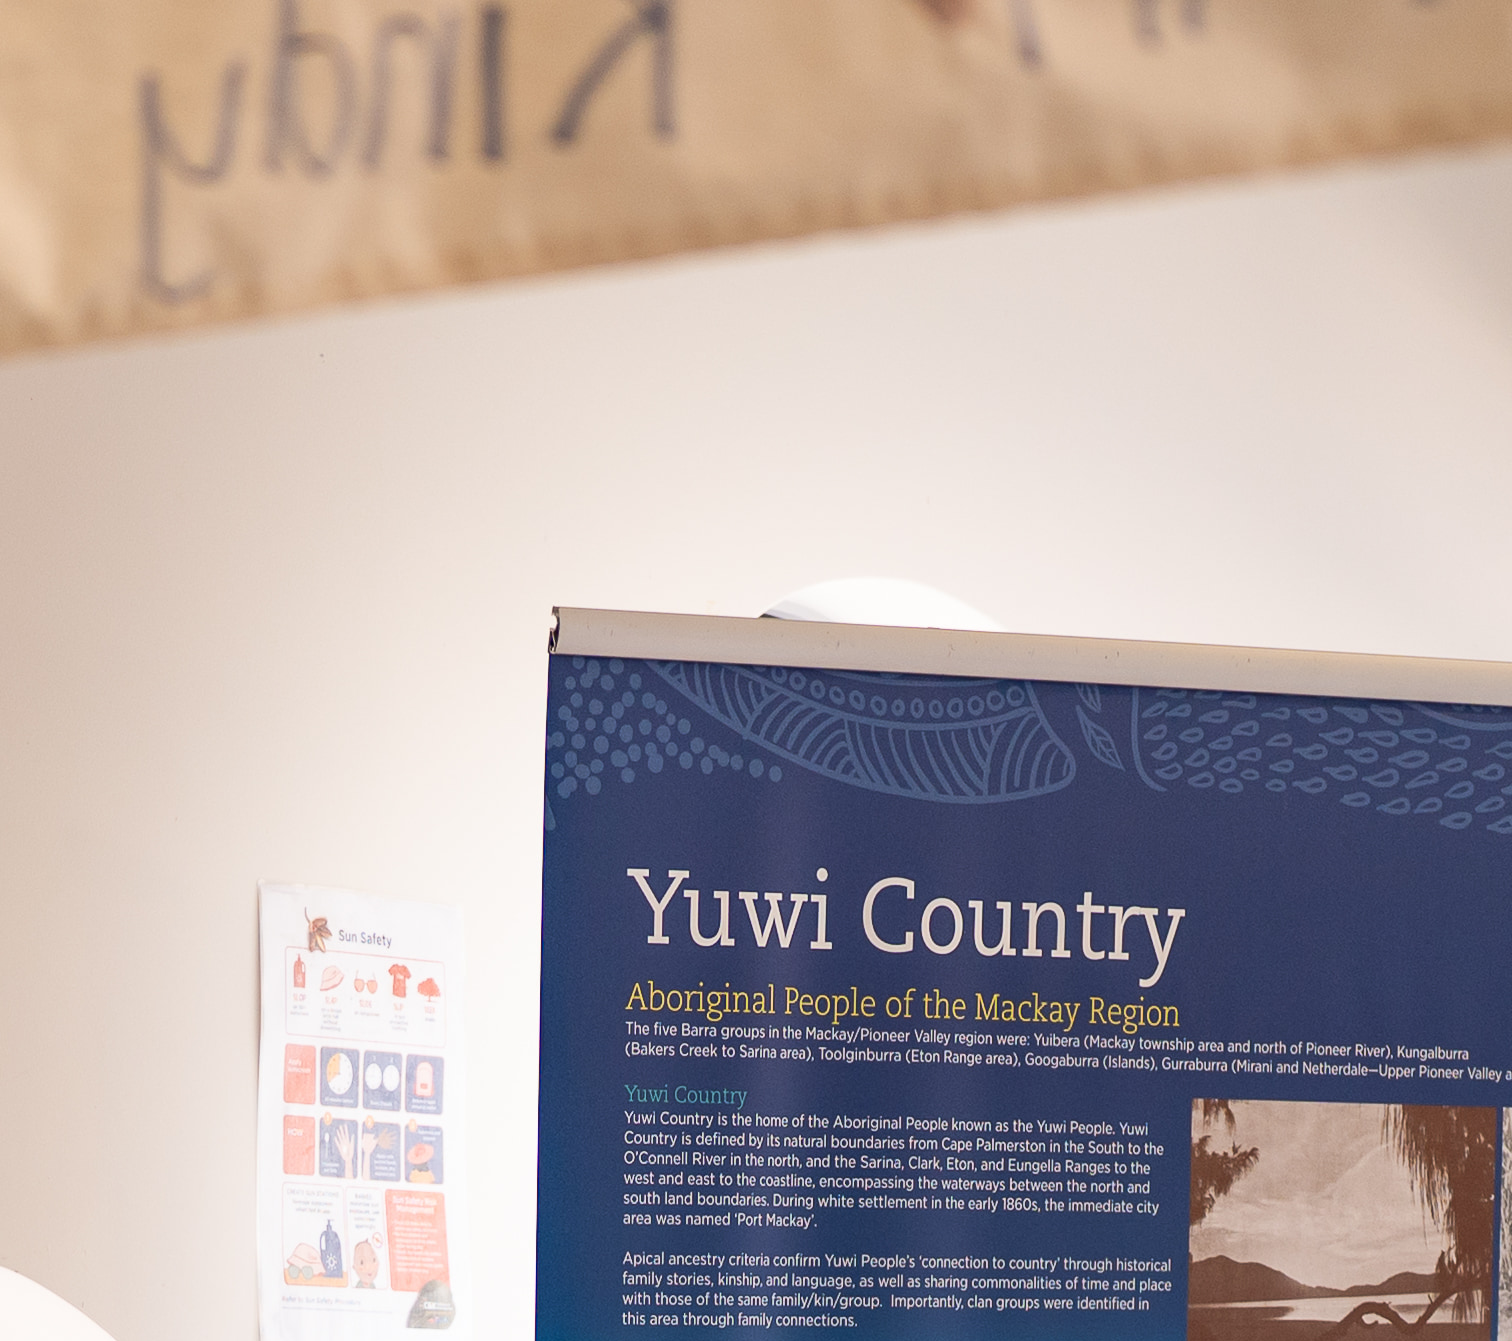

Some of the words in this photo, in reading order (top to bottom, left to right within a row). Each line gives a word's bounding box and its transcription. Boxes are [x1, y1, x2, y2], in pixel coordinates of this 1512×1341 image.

[339, 929, 358, 944] Sun
[360, 931, 393, 949] Safety
[627, 867, 834, 950] Yuwi
[862, 876, 1185, 988] Country
[624, 979, 776, 1022] Aboriginal
[784, 985, 876, 1025] People
[884, 987, 916, 1018] of
[922, 988, 966, 1020] the
[974, 991, 1080, 1032] Mackay
[1088, 995, 1180, 1034] Region
[623, 1083, 668, 1103] Yuwi
[674, 1084, 747, 1109] Country
